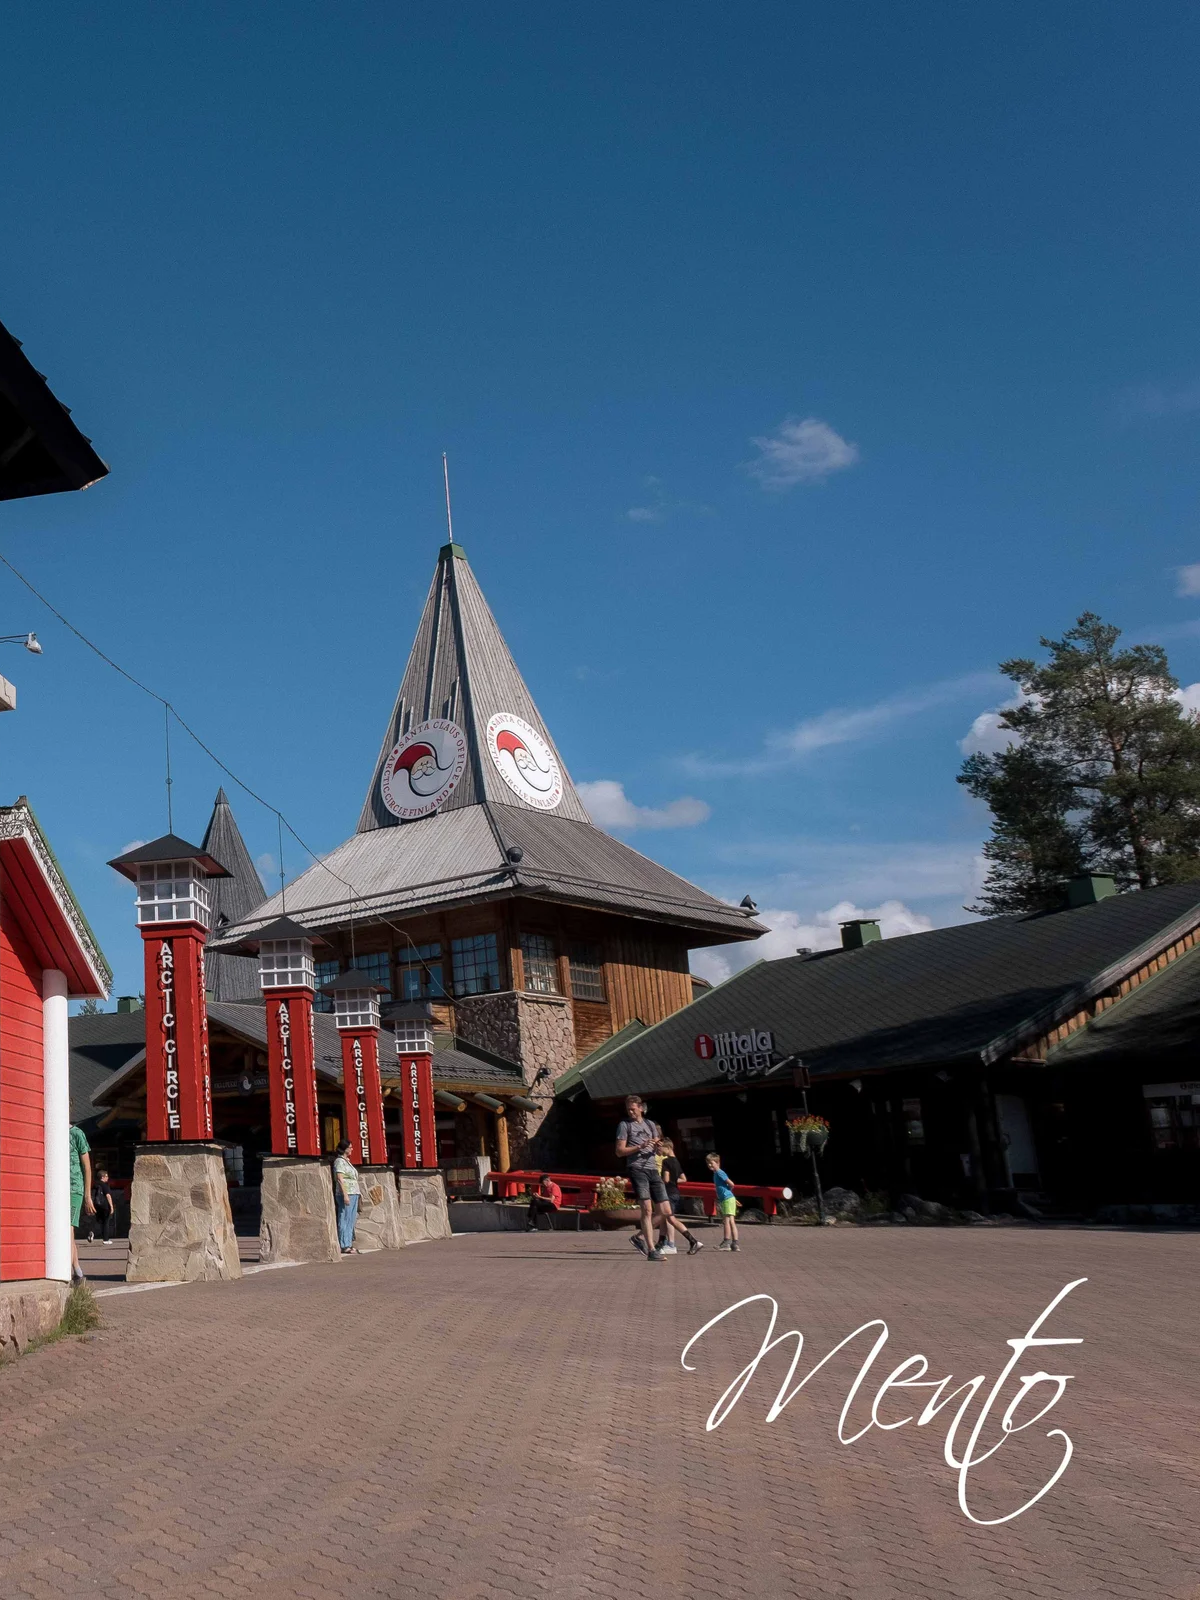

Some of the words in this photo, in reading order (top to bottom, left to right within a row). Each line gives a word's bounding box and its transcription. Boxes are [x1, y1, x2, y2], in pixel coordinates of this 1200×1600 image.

[383, 756, 395, 793] ARCTIC
[399, 723, 430, 748] SANTA
[433, 721, 460, 739] CLAUS
[452, 739, 465, 780] OFFICE
[488, 730, 502, 766] ARCTIC
[500, 768, 529, 800] CIRCLE
[528, 792, 559, 807] FINLAND
[491, 714, 515, 728] SANTA
[516, 718, 544, 746] CLAUS
[545, 749, 561, 789] OFFICE
[384, 793, 409, 817] CIRCLE
[408, 789, 449, 817] FINLAND
[160, 942, 175, 1027] ARCTIC
[278, 1003, 292, 1070] ARCTIC
[713, 1028, 773, 1057] iittala
[717, 1051, 773, 1073] OUTLET
[164, 1039, 180, 1129] CIRCLE
[203, 1044, 211, 1132] CIRCLE
[353, 1039, 364, 1094] ARCTIC
[410, 1062, 419, 1108] ARCTIC
[284, 1078, 296, 1148] CIRCLE
[358, 1102, 370, 1158] CIRCLE
[413, 1114, 421, 1162] CIRCLE
